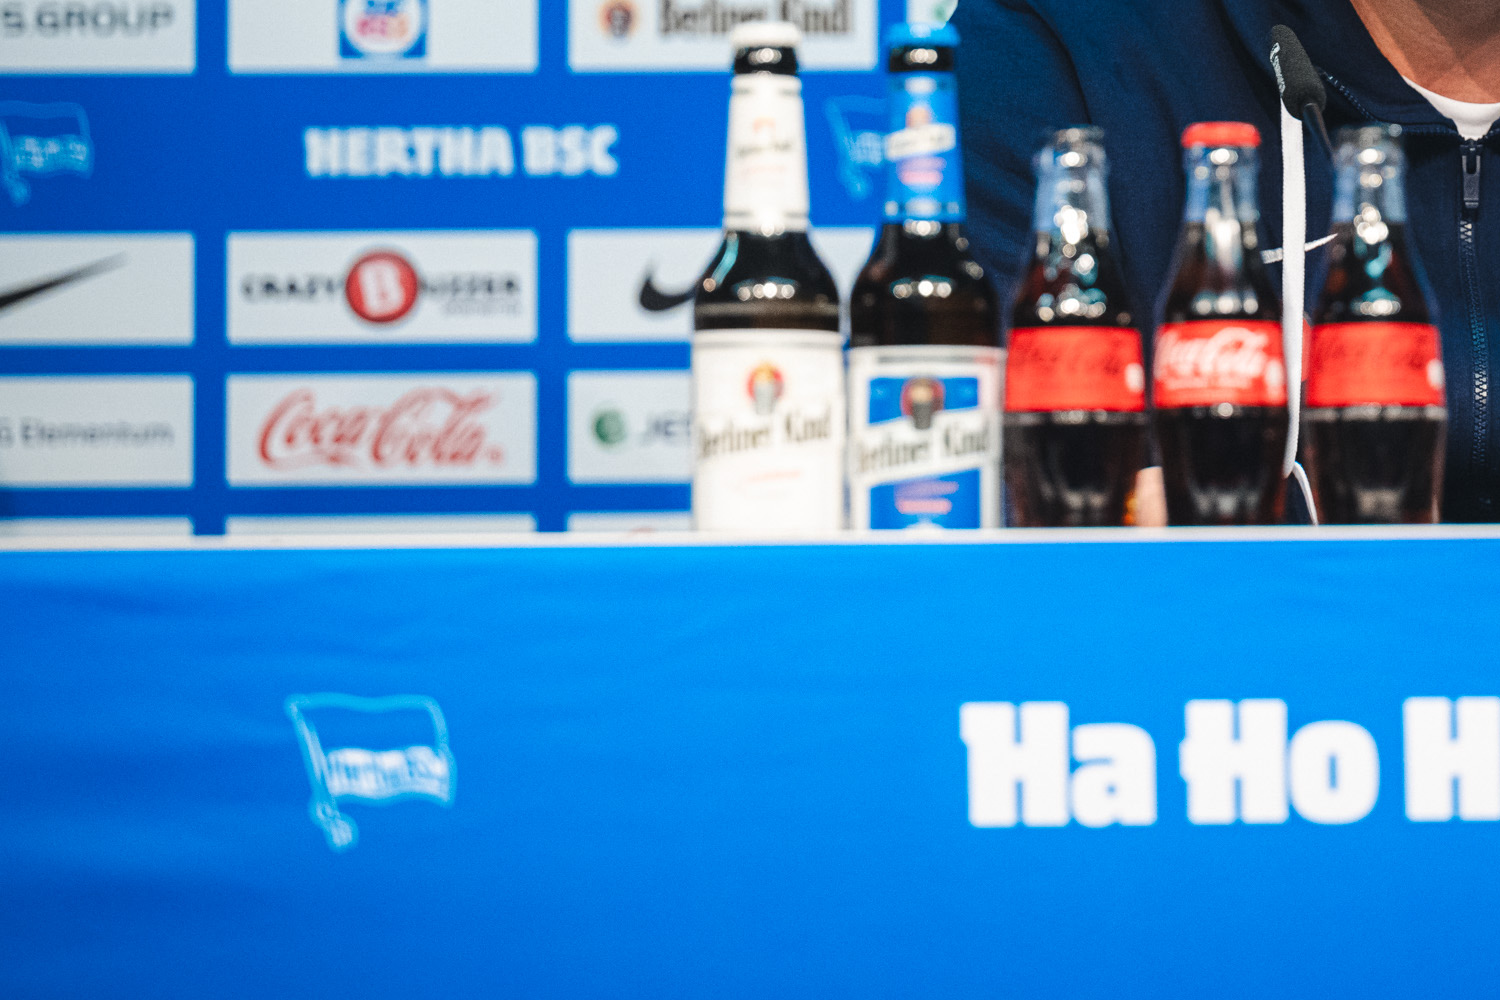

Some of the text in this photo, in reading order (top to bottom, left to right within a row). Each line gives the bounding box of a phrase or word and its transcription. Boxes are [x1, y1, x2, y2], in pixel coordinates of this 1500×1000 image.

[306, 125, 618, 177] HERTHA BSC
[960, 702, 1157, 827] Ha
[1180, 699, 1379, 825] Ho
